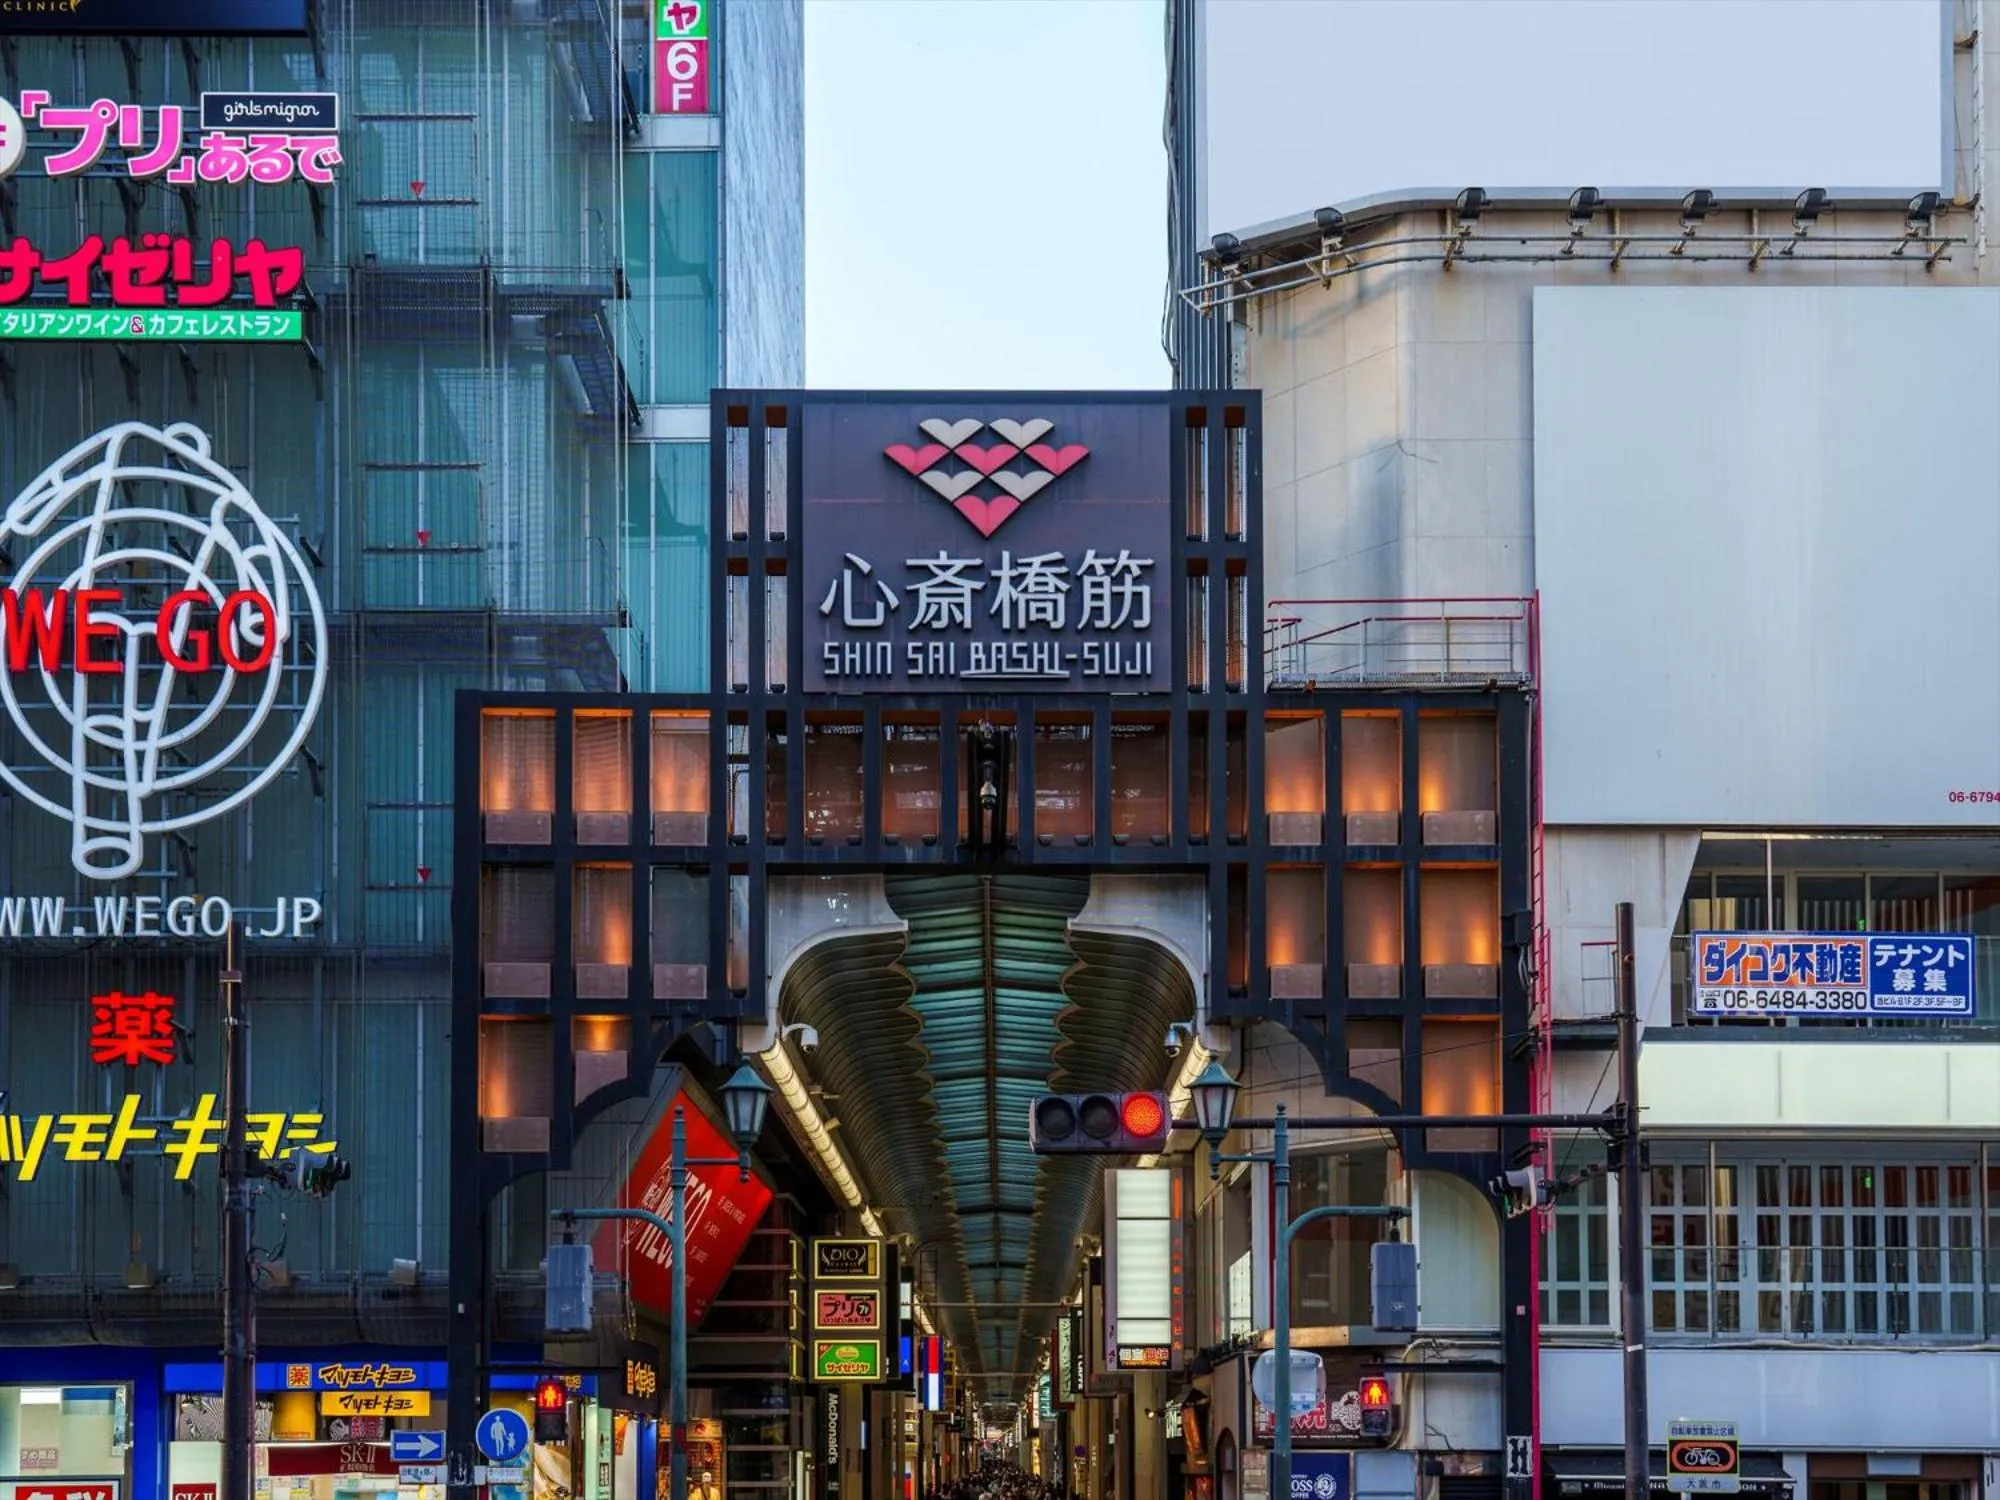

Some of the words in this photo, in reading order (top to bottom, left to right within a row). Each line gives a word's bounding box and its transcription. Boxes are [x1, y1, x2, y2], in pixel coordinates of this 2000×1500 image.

[3, 0, 68, 11] CLINIC
[0, 313, 290, 336] タリアンワイン&カフェレストラン
[819, 549, 1155, 631] 心斎橋筋
[823, 641, 893, 677] SHIN
[906, 641, 956, 677] SAI
[1703, 940, 1864, 984] ダイコク不動産
[1874, 943, 1966, 968] テナント
[1892, 968, 1948, 992] 募集
[1723, 989, 1868, 1010] 06-6484-3380
[90, 991, 176, 1067] 薬
[288, 1364, 311, 1387] 薬
[318, 1363, 416, 1388] マツモトキヨシ
[339, 1394, 414, 1413] マツモトキヨシ
[828, 1393, 838, 1464] McDonald's
[1291, 1480, 1313, 1492] OSS
